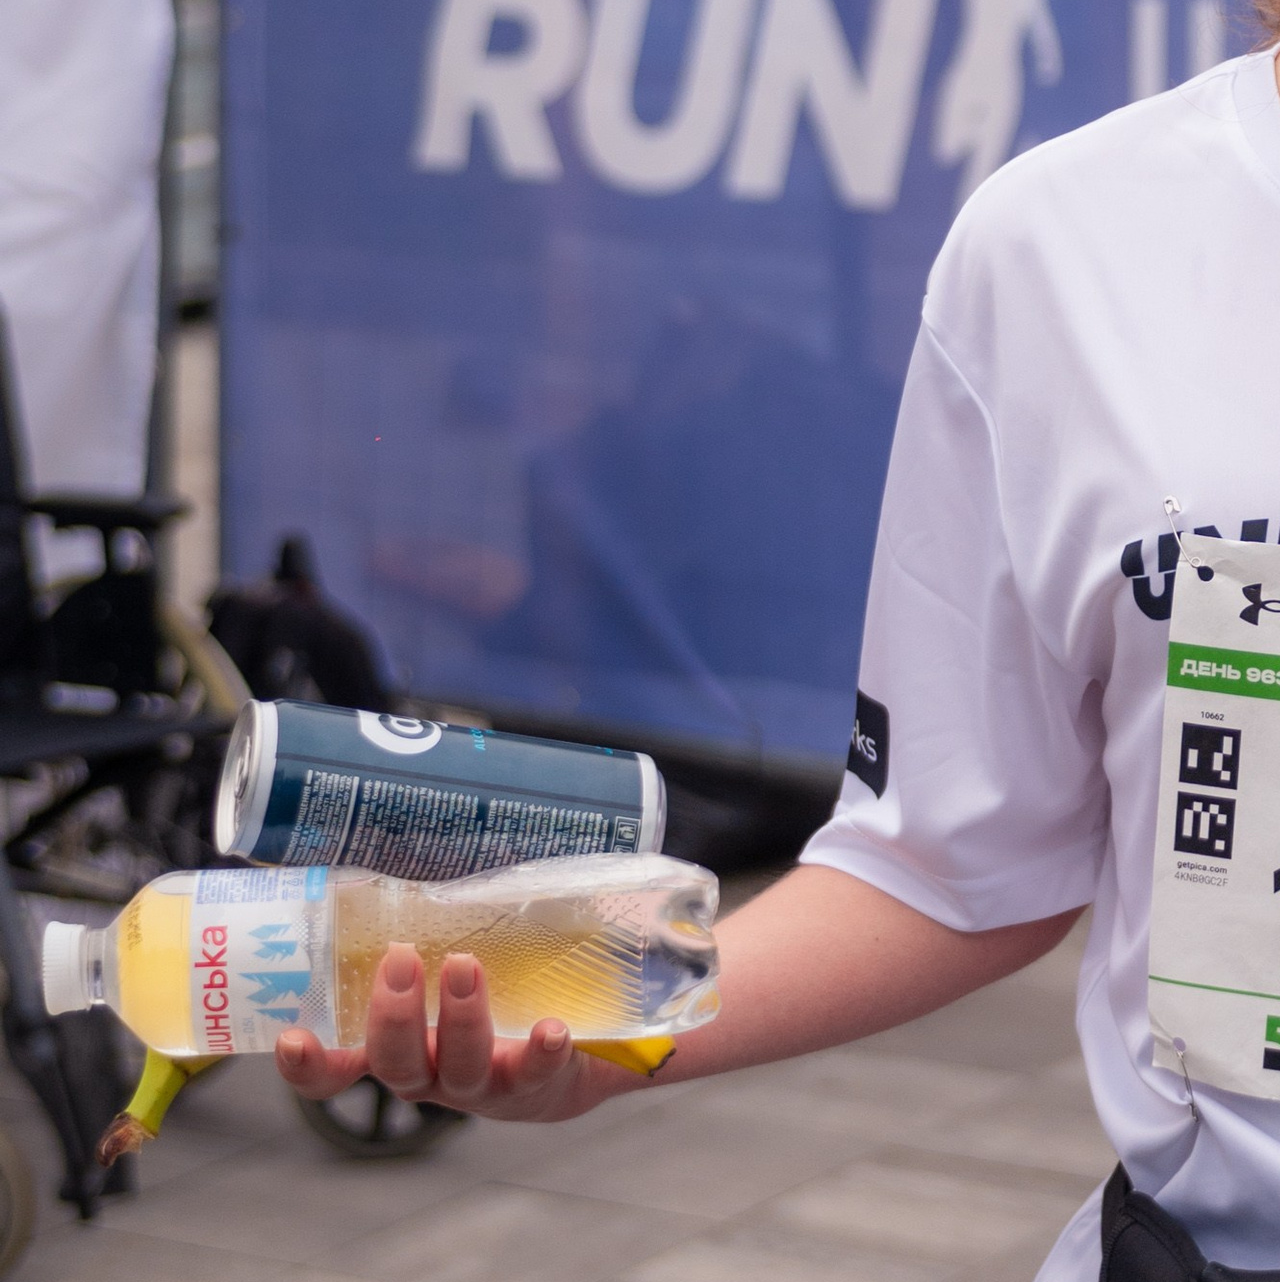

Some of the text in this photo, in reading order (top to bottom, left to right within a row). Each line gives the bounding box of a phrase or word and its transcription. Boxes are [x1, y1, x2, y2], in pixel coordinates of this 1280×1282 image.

[1180, 659, 1241, 681] ДЕНЬ
[1201, 711, 1225, 721] 10662
[1177, 860, 1228, 874] getpica.com
